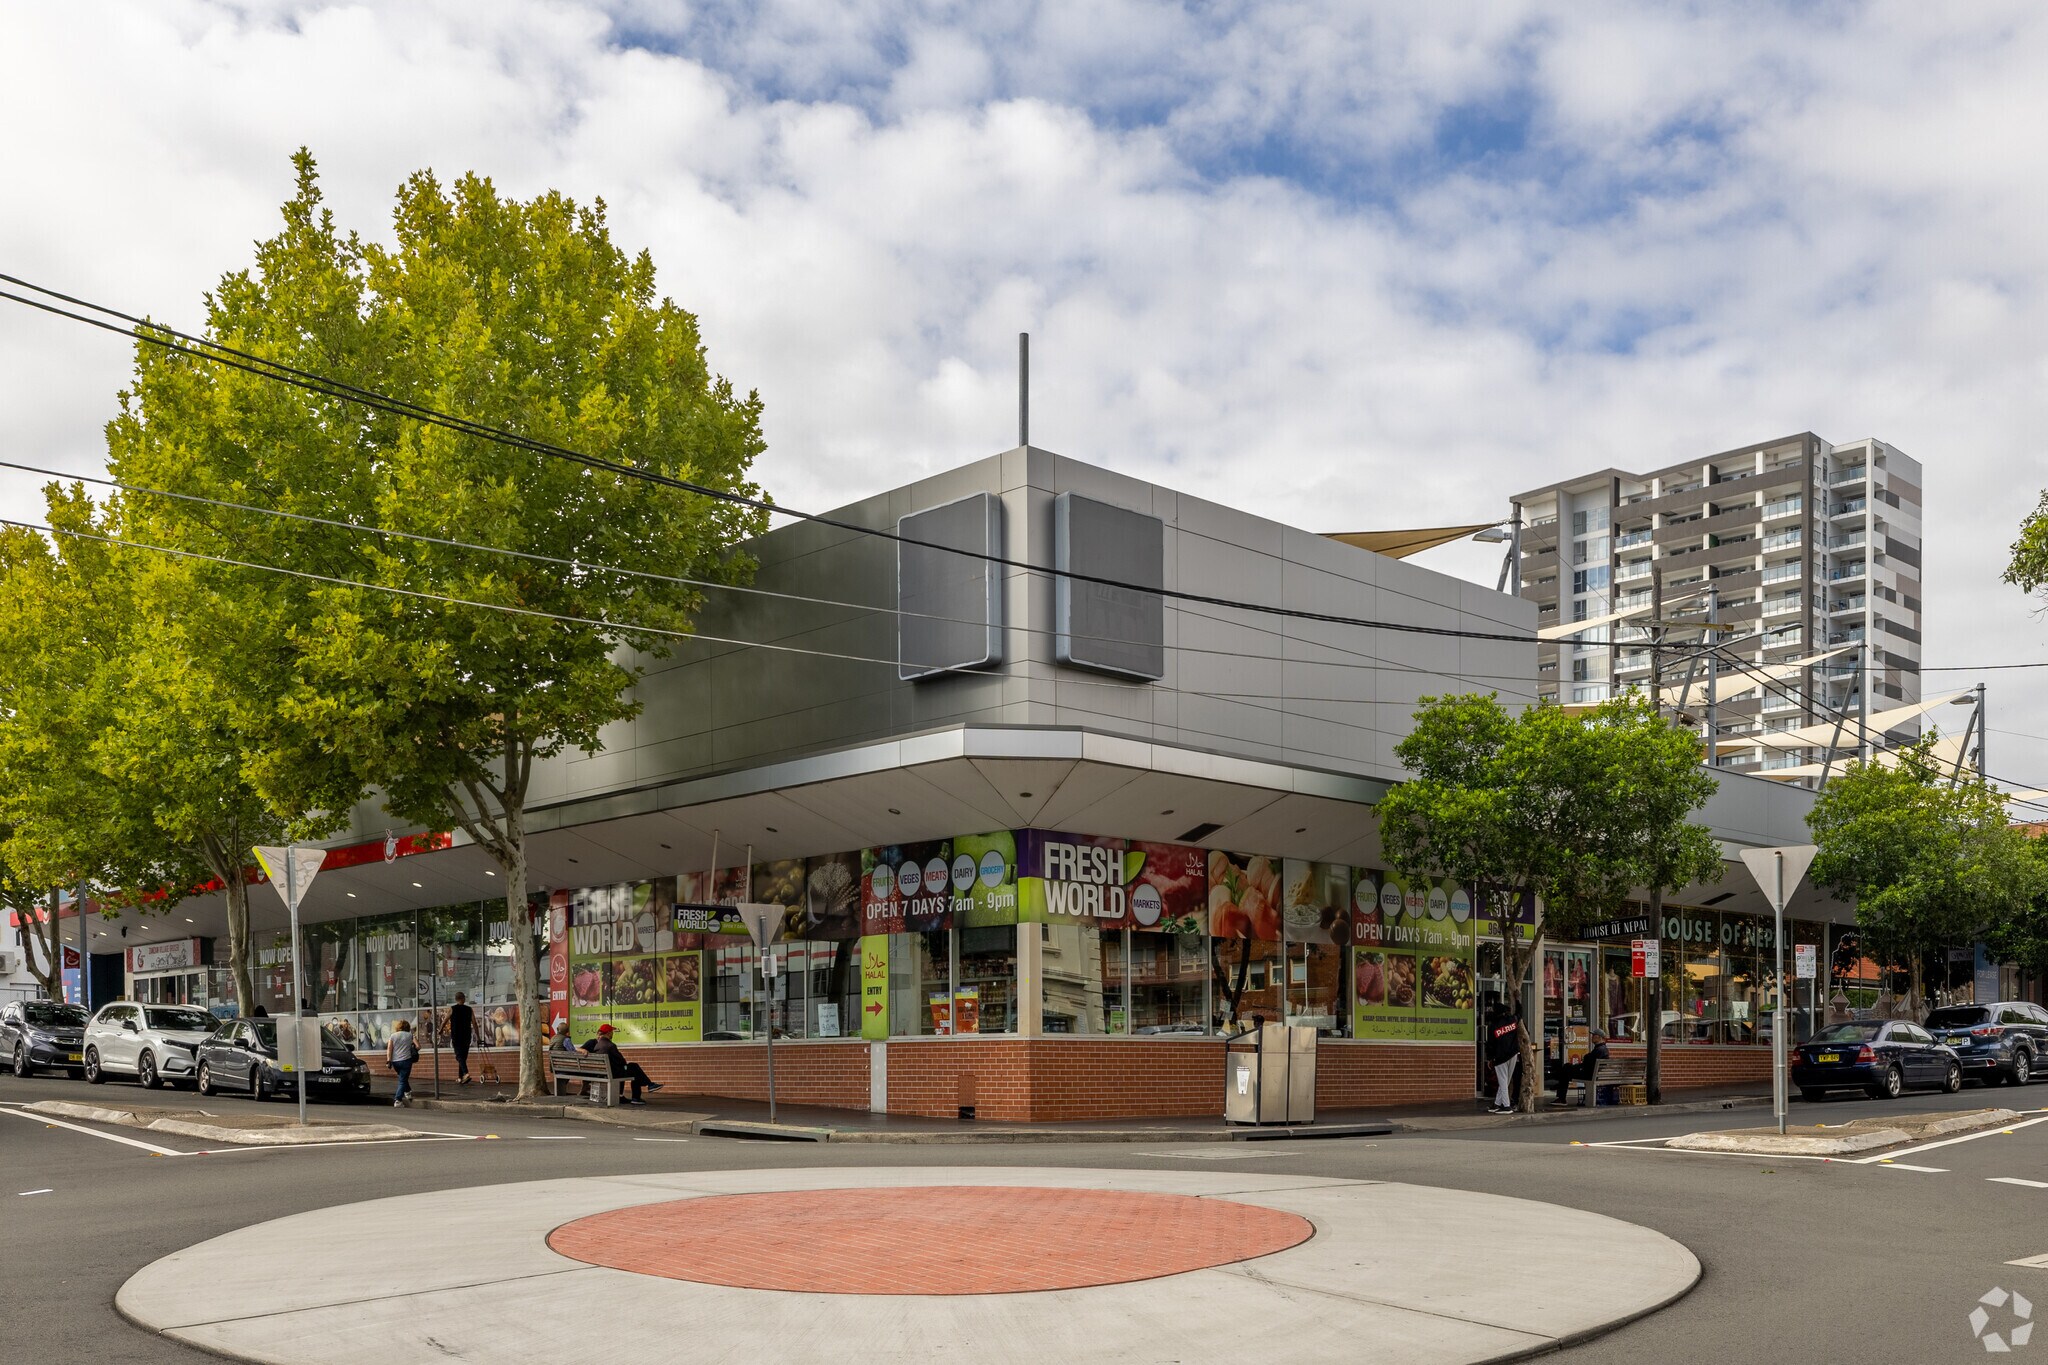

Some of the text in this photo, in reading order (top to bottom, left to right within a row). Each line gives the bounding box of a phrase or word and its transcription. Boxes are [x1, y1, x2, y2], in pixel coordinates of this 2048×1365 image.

[1044, 841, 1124, 886] FRESH
[1186, 868, 1204, 877] HALAL
[872, 865, 1004, 887] FRUITS VEGES MEATS DAIRY GROCERY
[572, 886, 634, 926] FRESH
[866, 901, 898, 920] OPEN
[901, 900, 909, 916] 7
[912, 896, 945, 916] DAYS
[948, 895, 974, 912] 7am
[987, 892, 1014, 912] 9pm
[1043, 879, 1125, 919] WORLD
[1133, 898, 1160, 910] MARKETS
[1357, 891, 1377, 903] FRUITS
[1382, 894, 1400, 906] VEGES
[1406, 896, 1424, 907] MEATS
[1430, 899, 1447, 910] DAIRY
[677, 909, 708, 920] FRESH
[489, 920, 512, 939] NOW
[677, 919, 708, 930] WORLD
[1583, 919, 1648, 939] HOUSE OF NEPAL
[366, 932, 410, 953] NOW OPEN
[572, 921, 635, 955] WORLD
[1356, 922, 1382, 940] OPEN
[1386, 926, 1392, 941] 7
[1395, 926, 1420, 943] DAYS
[1423, 928, 1442, 944] 7am
[1451, 930, 1470, 949] 9pm
[1721, 923, 1741, 945] OF
[1746, 925, 1790, 950] NEPL
[259, 948, 276, 965] NOW
[864, 952, 886, 970] حلال
[865, 970, 886, 979] HALAL
[552, 990, 567, 1001] ENTRY
[867, 986, 883, 996] ENTRY
[1496, 1023, 1517, 1037] PARIS
